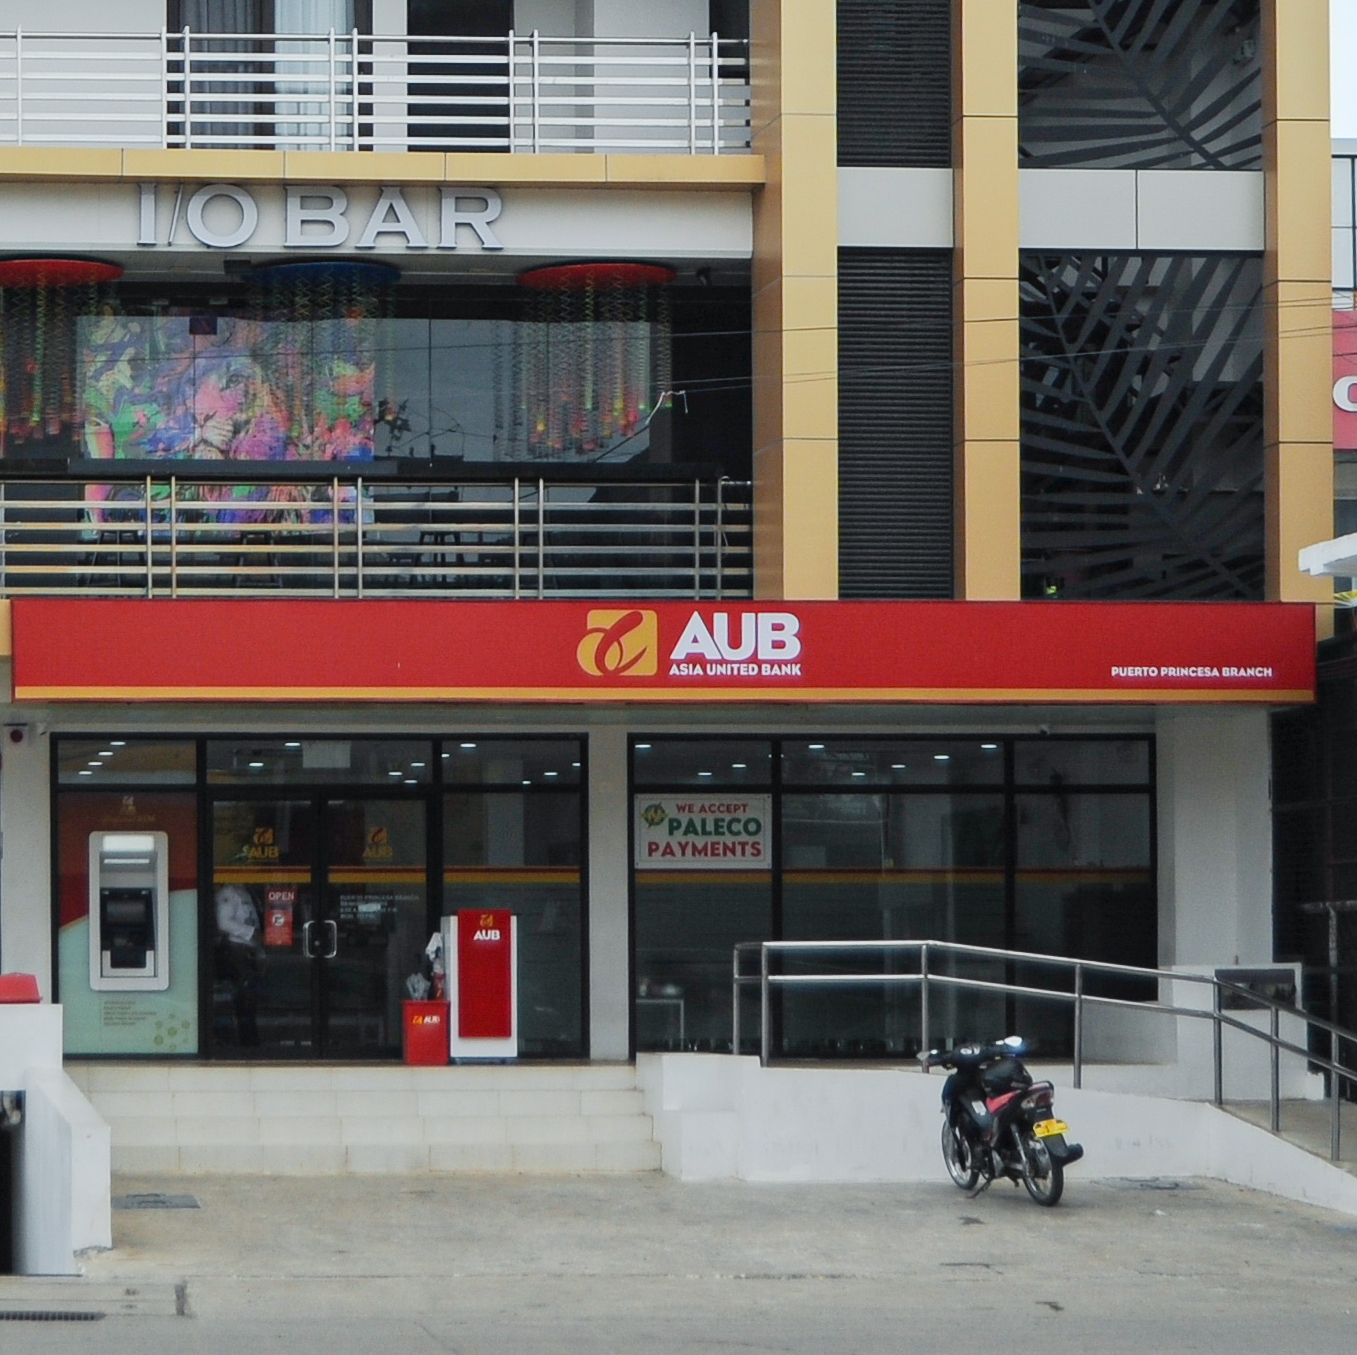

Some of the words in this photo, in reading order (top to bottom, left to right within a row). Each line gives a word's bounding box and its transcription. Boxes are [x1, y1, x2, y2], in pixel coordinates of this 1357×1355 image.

[283, 185, 504, 249] BAR
[670, 611, 802, 660] AUB
[669, 663, 703, 676] ASIA
[706, 663, 759, 676] UNITED
[761, 663, 802, 676] BANK
[1111, 666, 1158, 677] PUERTO
[1160, 666, 1219, 677] PRINCESA
[1221, 666, 1273, 677] BRANCH
[676, 803, 695, 813] WE
[698, 803, 748, 813] ACCEPT
[668, 817, 762, 836] PALECO
[249, 846, 279, 858] AUB
[647, 841, 762, 858] PAYMENTS
[268, 892, 294, 901] OPEN
[473, 929, 500, 941] AUB
